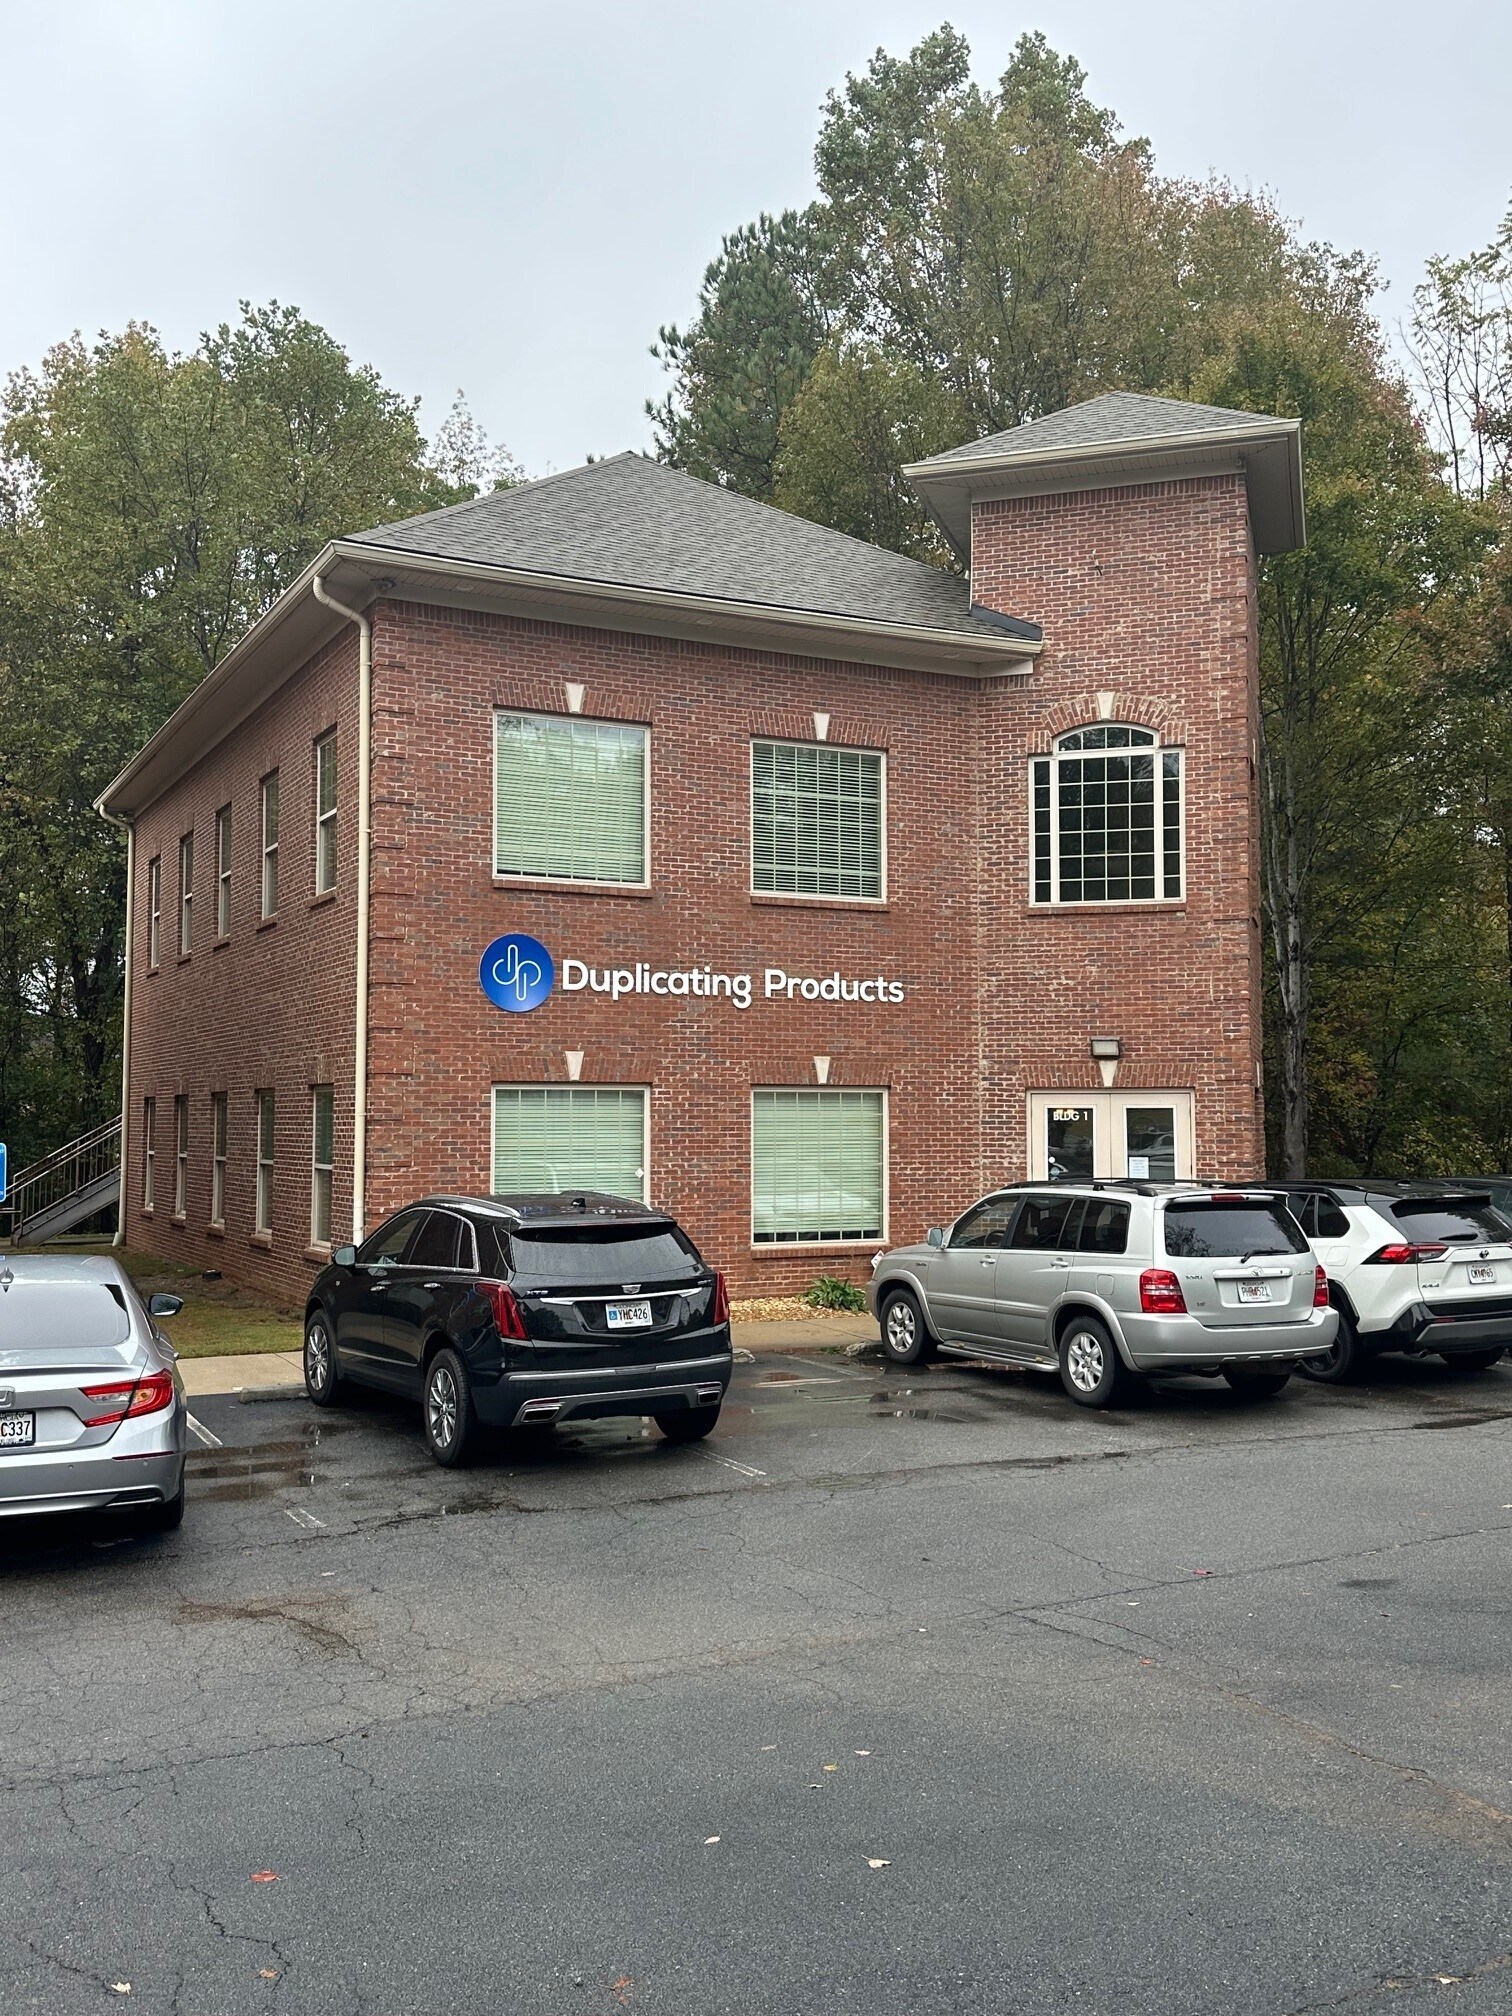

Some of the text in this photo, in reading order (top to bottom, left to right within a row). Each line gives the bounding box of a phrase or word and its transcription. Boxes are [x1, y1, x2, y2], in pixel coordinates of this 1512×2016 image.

[561, 959, 905, 1009] Duplicating Products
[1053, 1110, 1088, 1121] BLDG 1
[1, 1420, 31, 1437] C337
